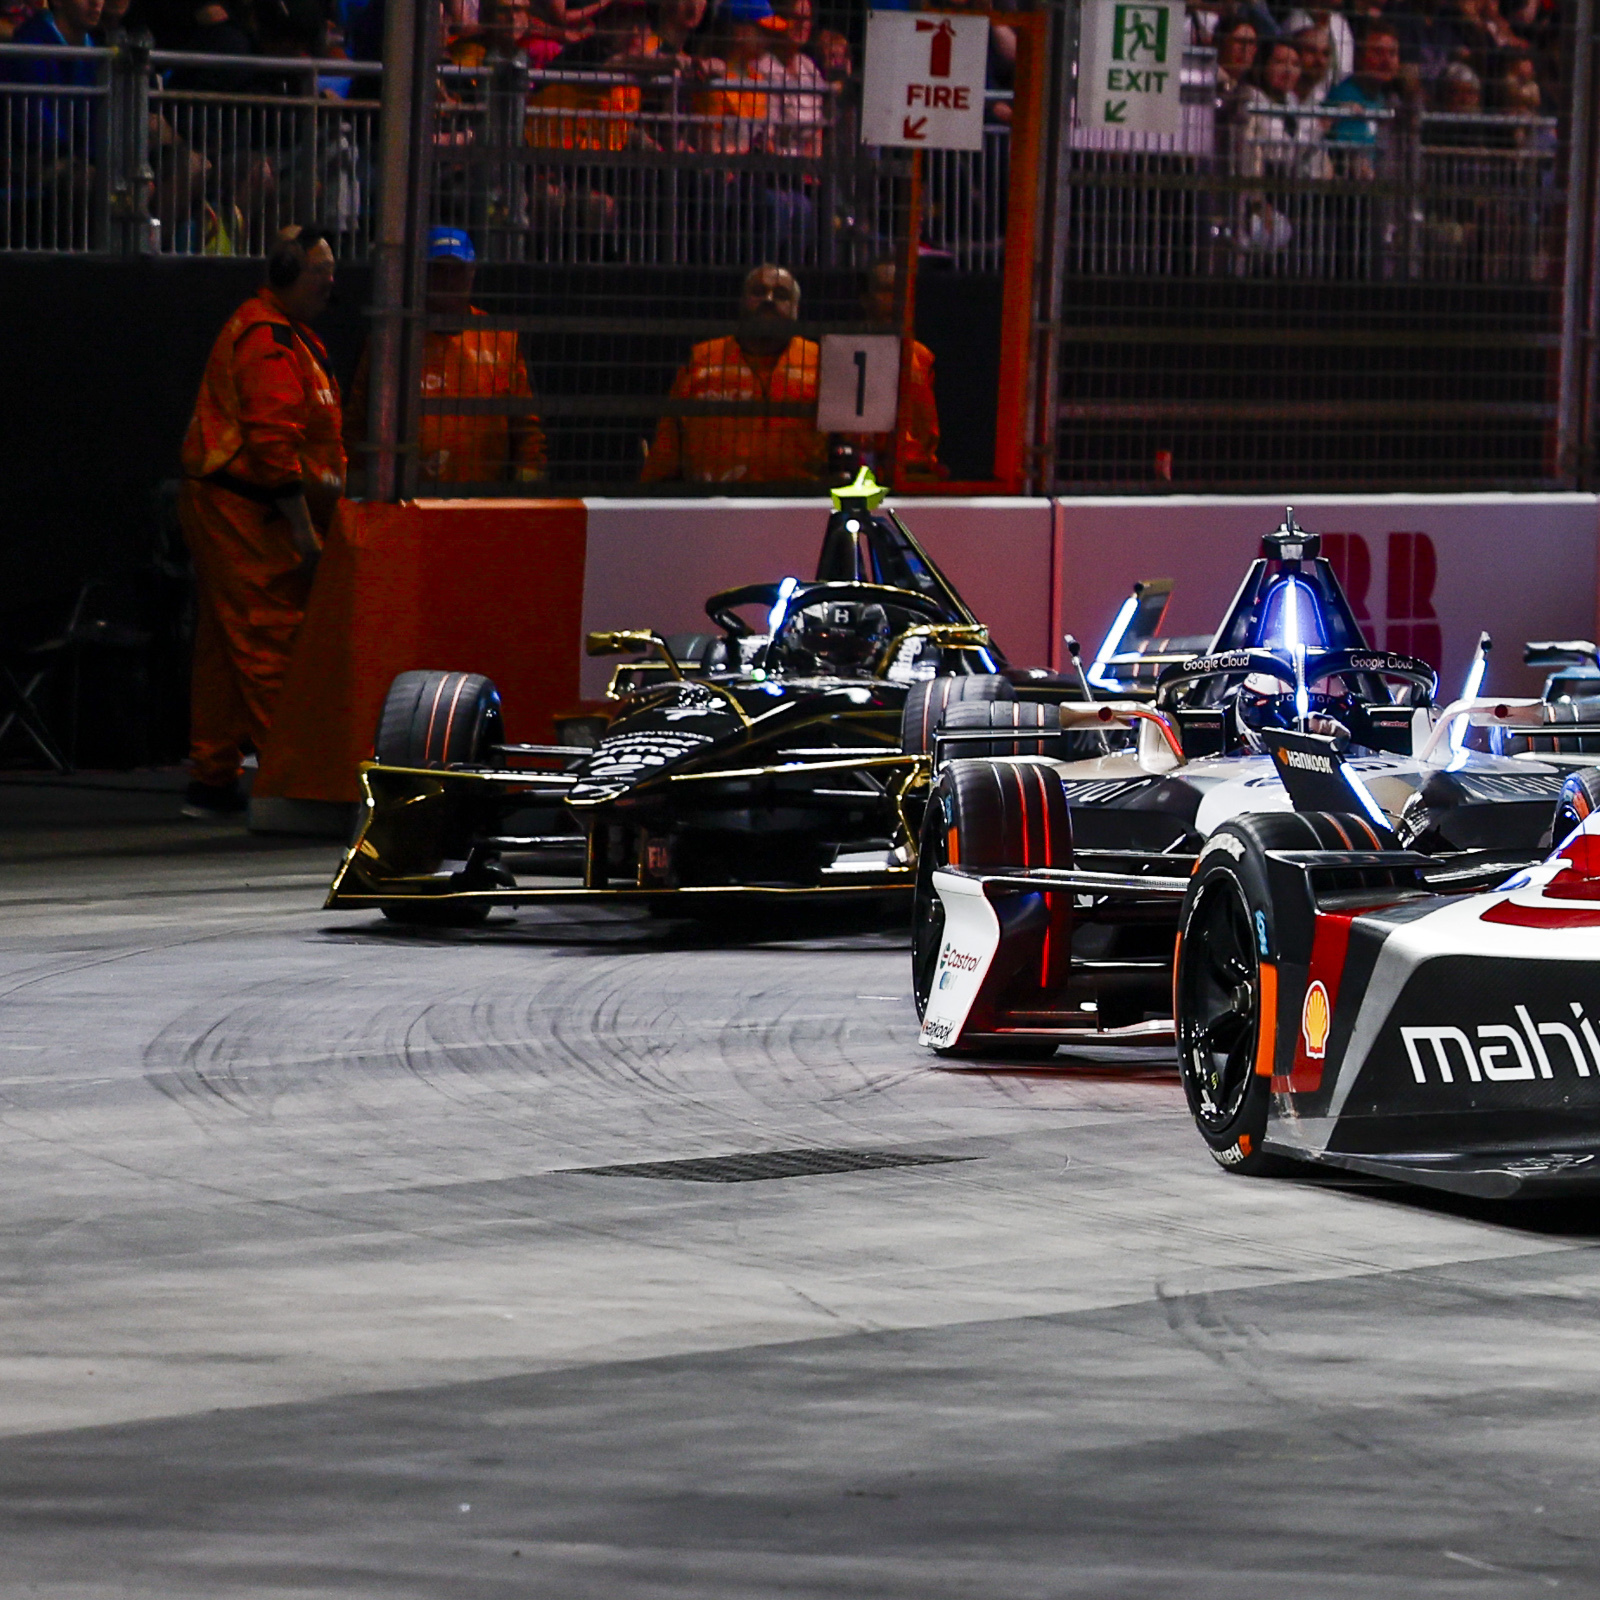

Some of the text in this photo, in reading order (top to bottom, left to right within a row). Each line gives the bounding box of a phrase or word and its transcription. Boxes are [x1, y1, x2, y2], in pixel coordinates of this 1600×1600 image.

[1108, 69, 1169, 94] EXIT
[907, 85, 970, 110] FIRE
[853, 350, 867, 417] 1
[1183, 654, 1250, 673] Google Cloud
[1351, 654, 1413, 670] Google Cloud
[1279, 693, 1332, 705] jauar
[947, 948, 982, 973] Castrol
